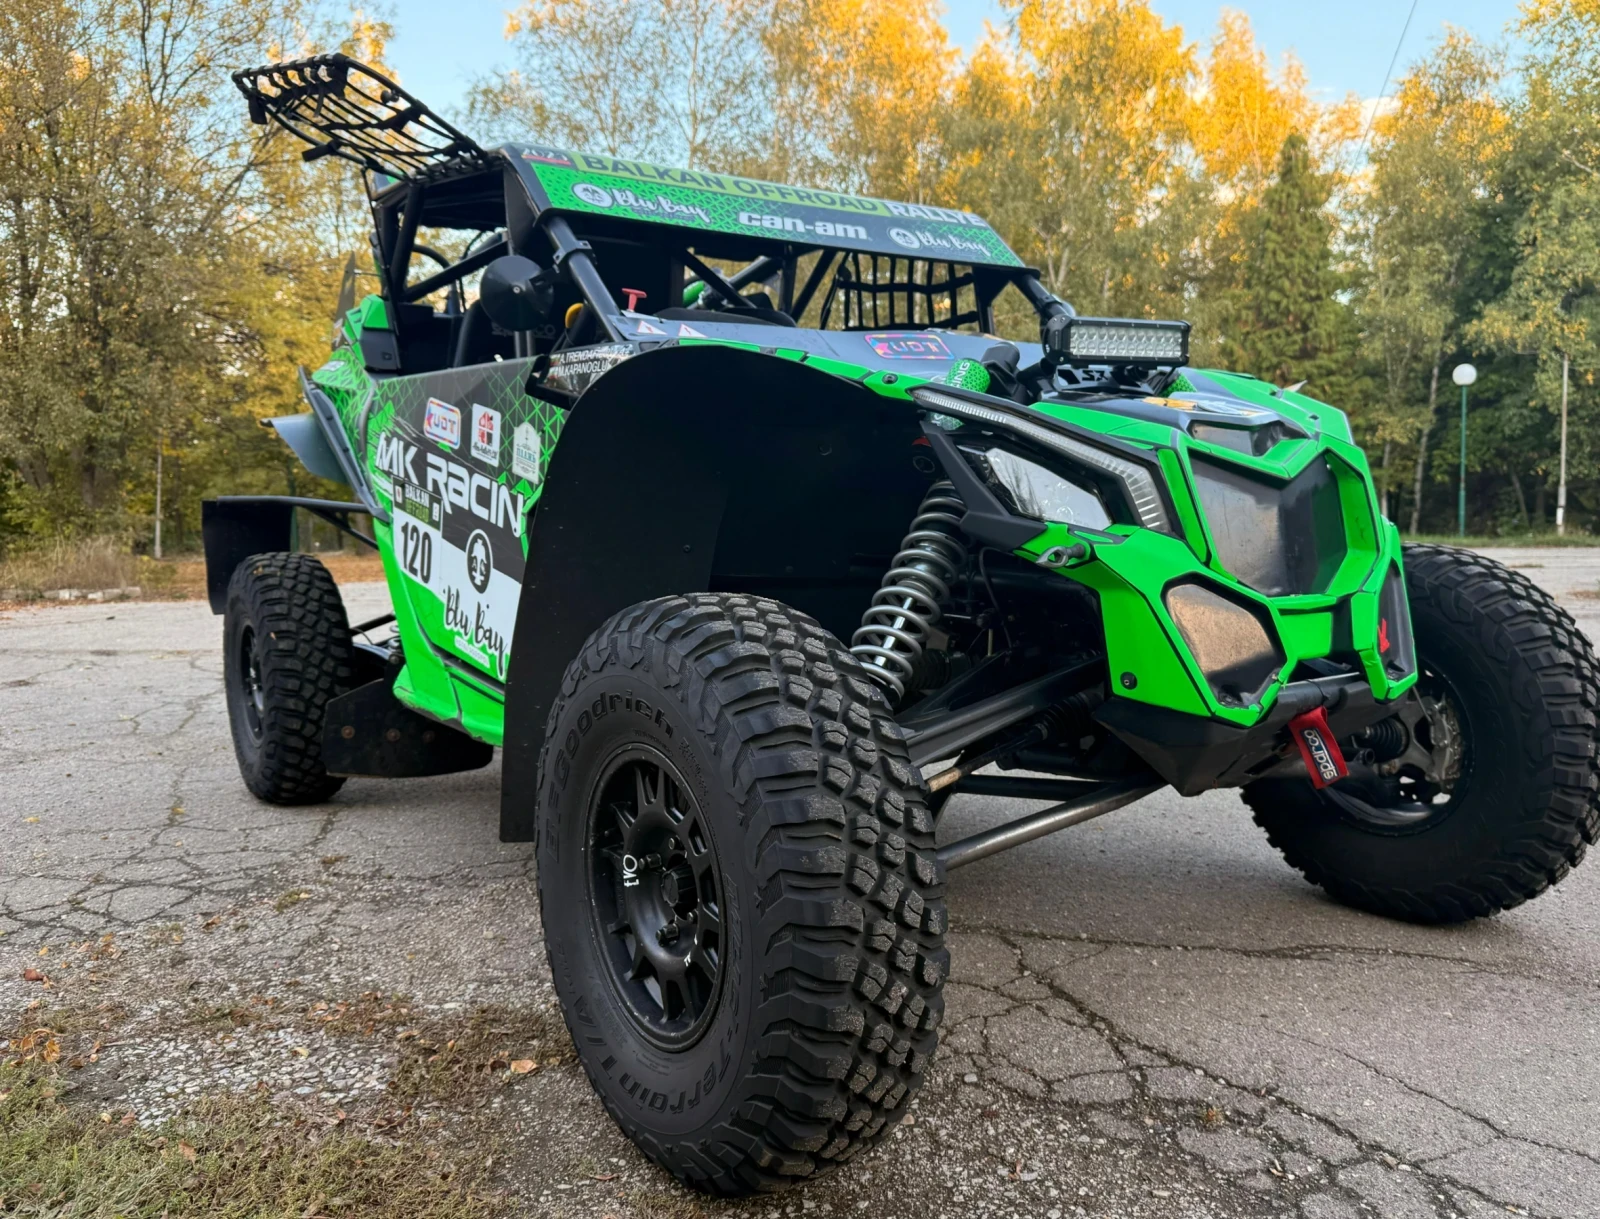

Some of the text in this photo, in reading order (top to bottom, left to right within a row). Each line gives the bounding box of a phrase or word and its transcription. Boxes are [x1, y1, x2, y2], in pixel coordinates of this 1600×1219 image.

[580, 154, 727, 191] BALKAN
[734, 179, 878, 213] OFFROAD
[885, 201, 988, 228] RALLYE
[738, 211, 868, 240] can-am
[375, 432, 419, 485] MK
[401, 521, 432, 584] 120
[1304, 729, 1338, 780] sparco
[623, 854, 640, 888] EVO
